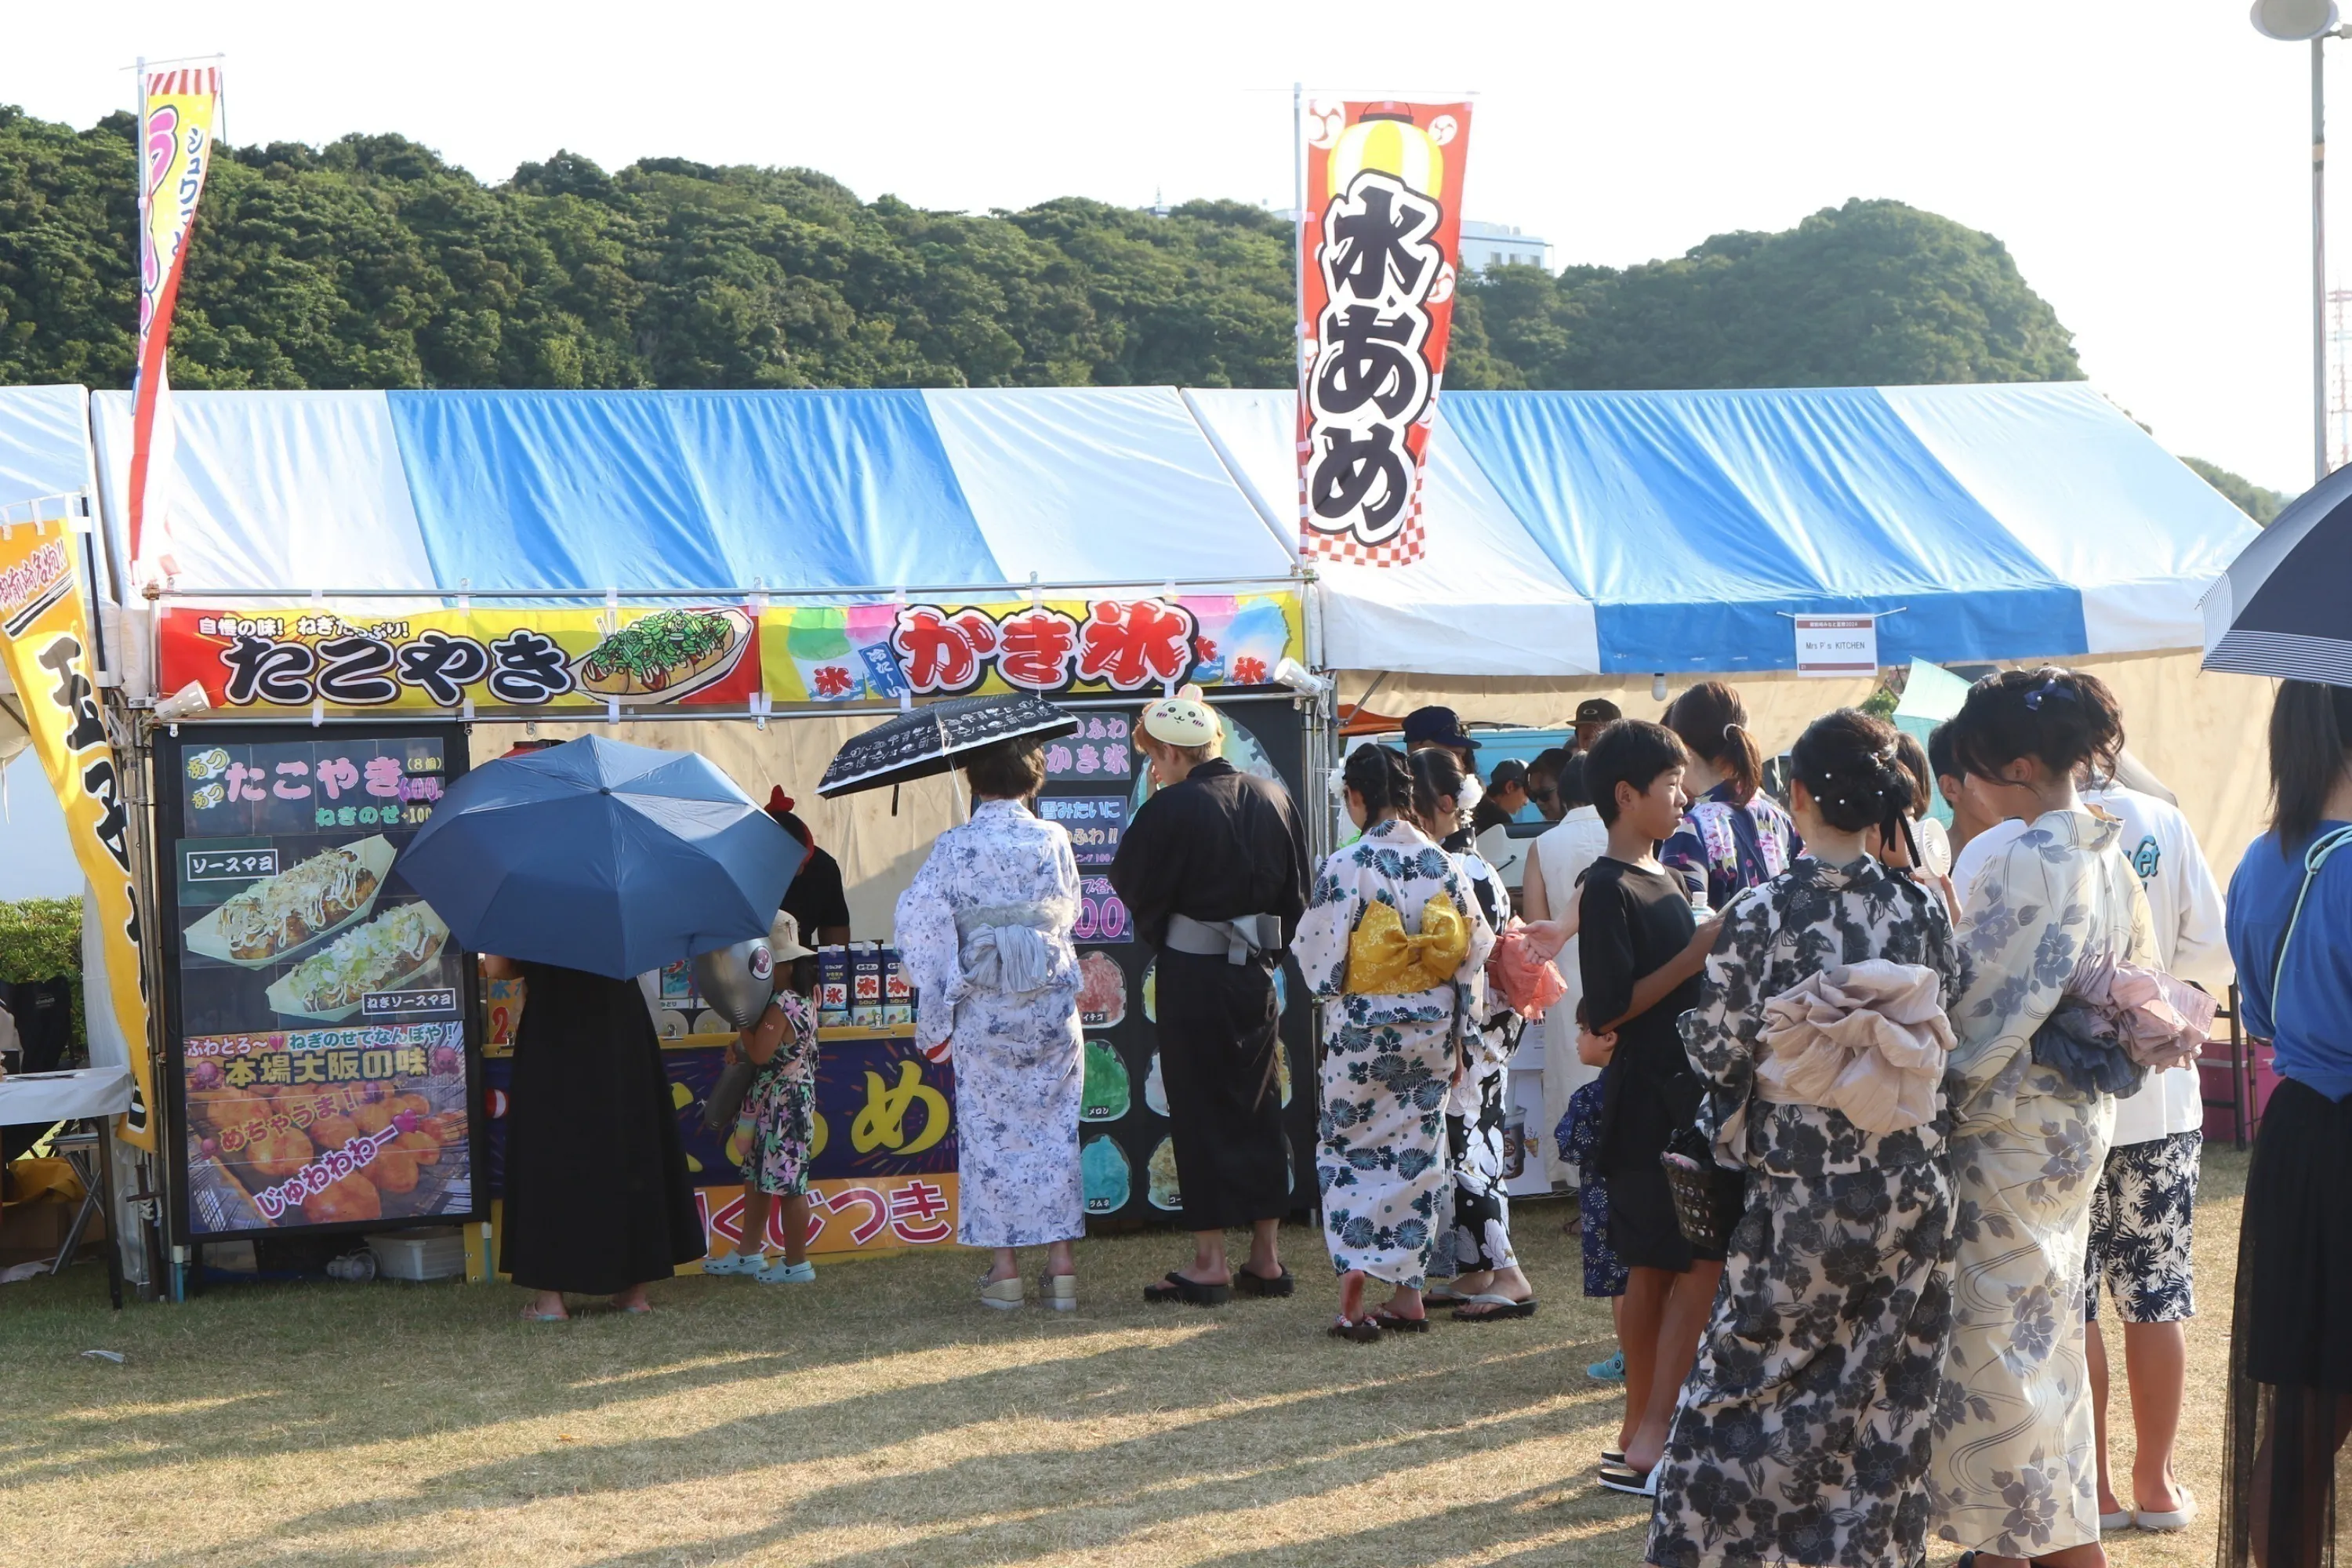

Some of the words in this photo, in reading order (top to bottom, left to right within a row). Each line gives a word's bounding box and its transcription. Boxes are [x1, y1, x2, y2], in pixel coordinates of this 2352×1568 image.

[1308, 171, 1444, 546] 水あめ
[893, 599, 1196, 693] かき氷
[220, 630, 576, 706] たこやき
[814, 666, 853, 695] 氷
[1047, 743, 1130, 775] かき氷
[224, 756, 403, 803] たこやき
[315, 805, 400, 826] ねぎのせ
[1040, 800, 1120, 819] 雪みたいに
[192, 857, 274, 873] ソースマヨ
[366, 994, 452, 1008] ねぎソースマヨ
[1083, 1013, 1104, 1022] イチゴ
[223, 1046, 430, 1087] 本場大阪の味
[1089, 1107, 1109, 1116] メロン
[255, 1124, 398, 1220] じゅわわわー
[1089, 1199, 1110, 1208] ラムネ
